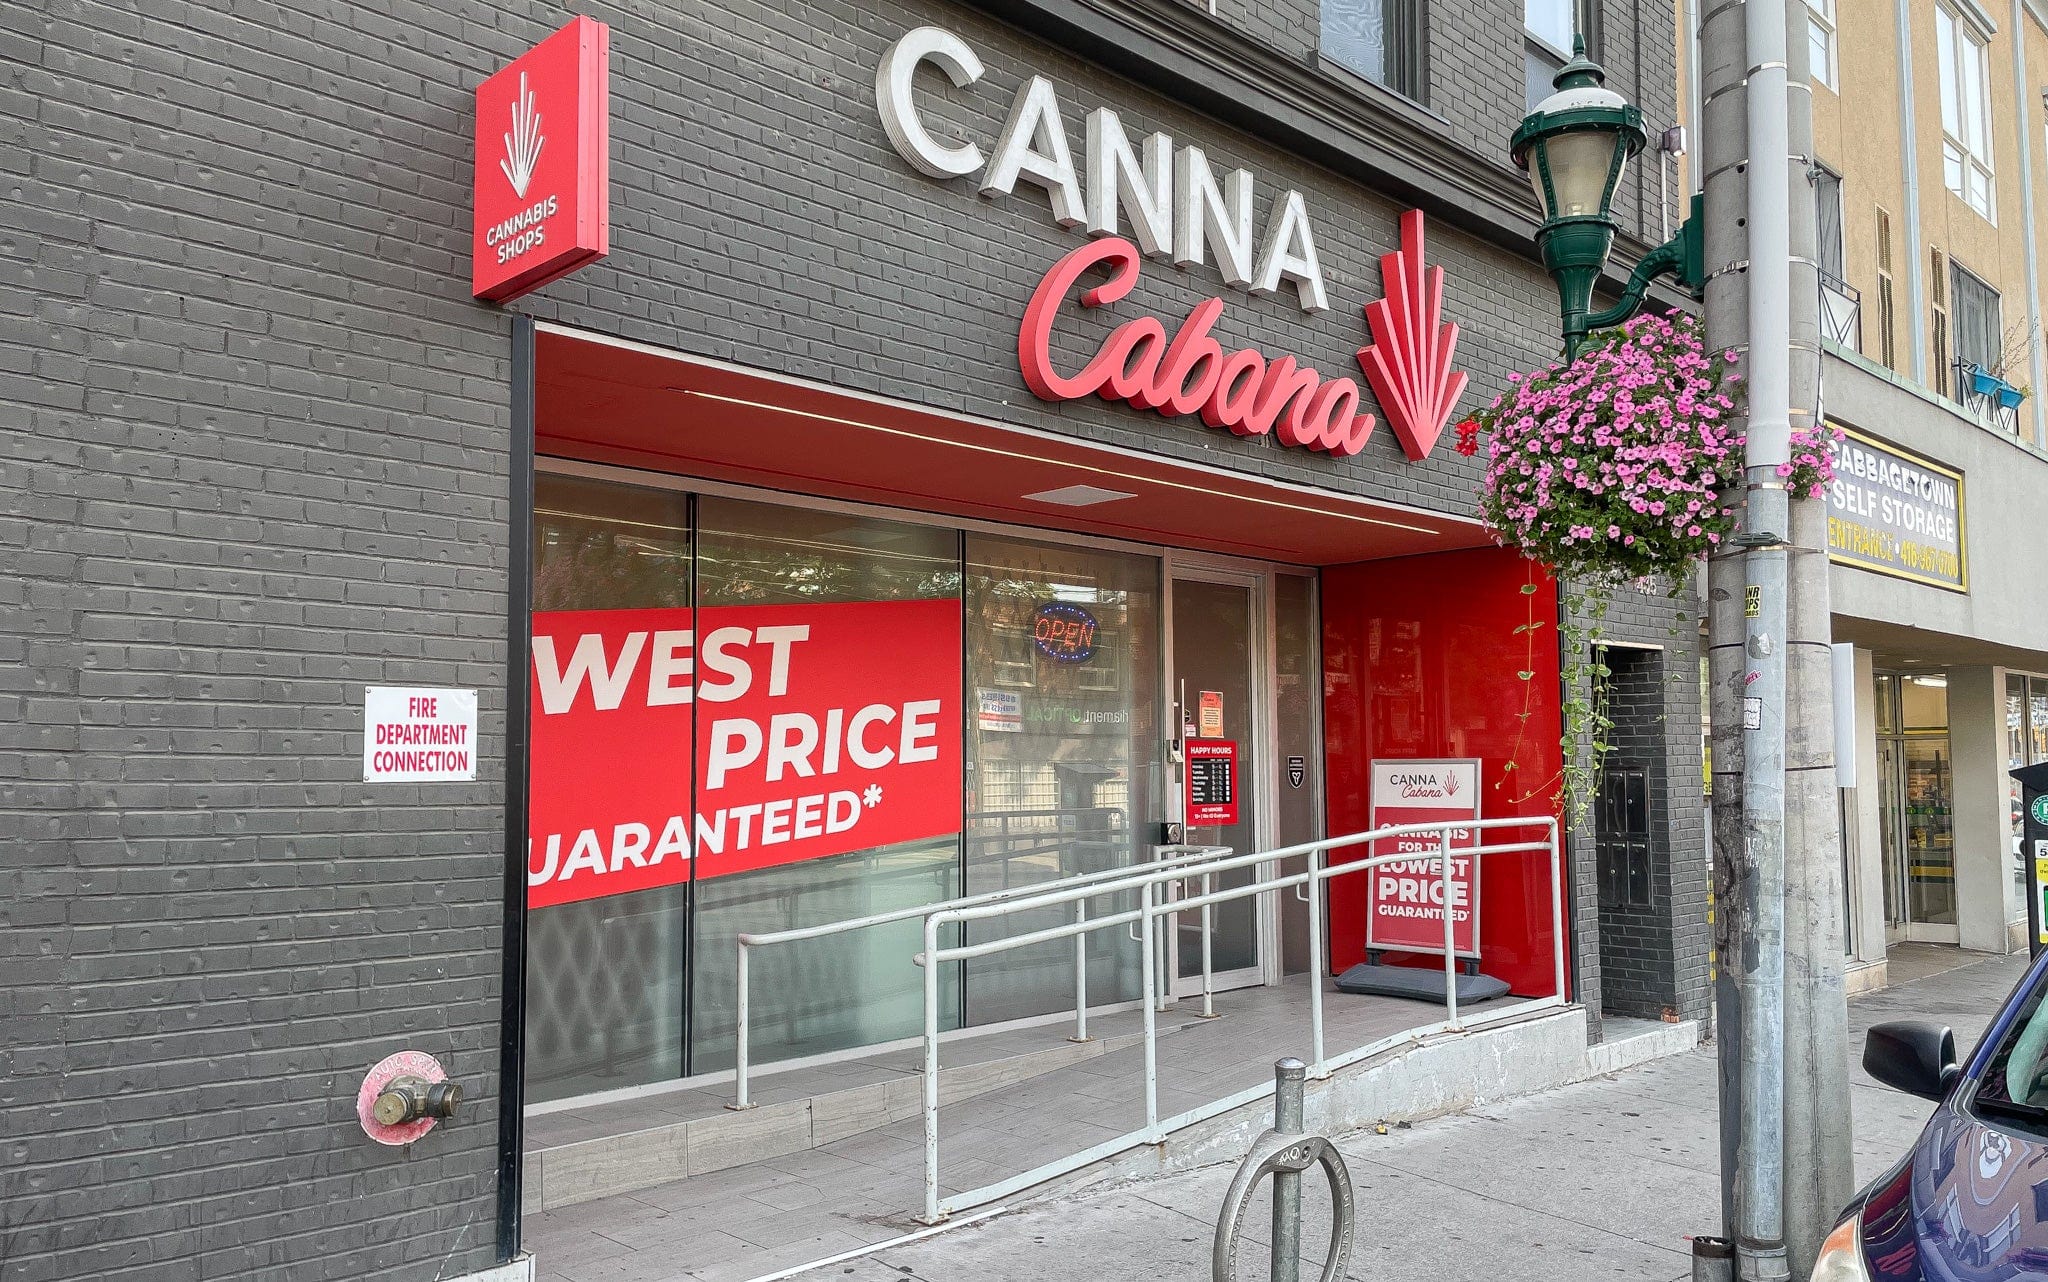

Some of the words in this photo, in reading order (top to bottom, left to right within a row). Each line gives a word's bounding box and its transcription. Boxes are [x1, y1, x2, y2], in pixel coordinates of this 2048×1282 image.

[875, 26, 1330, 314] CANNA
[486, 195, 558, 247] CANNABIS
[497, 226, 544, 264] SHOPS
[1018, 237, 1376, 458] Cabana
[1827, 440, 1955, 510] CABBAGETOWN
[1832, 479, 1877, 518] SELF
[1882, 495, 1954, 543] STORAGE
[1828, 516, 1894, 562] ENTRANCE
[1035, 618, 1095, 648] OPEN
[532, 624, 811, 716] WEST
[409, 697, 437, 718] FIRE
[376, 724, 468, 745] DEPARTMENT
[705, 699, 941, 791] PRICE
[373, 751, 468, 773] CONNECTION
[1390, 774, 1437, 786] CANNA
[1401, 783, 1443, 799] Cabana
[1398, 841, 1422, 852] FOR
[1425, 842, 1442, 852] TH
[1379, 876, 1468, 907] PRICE
